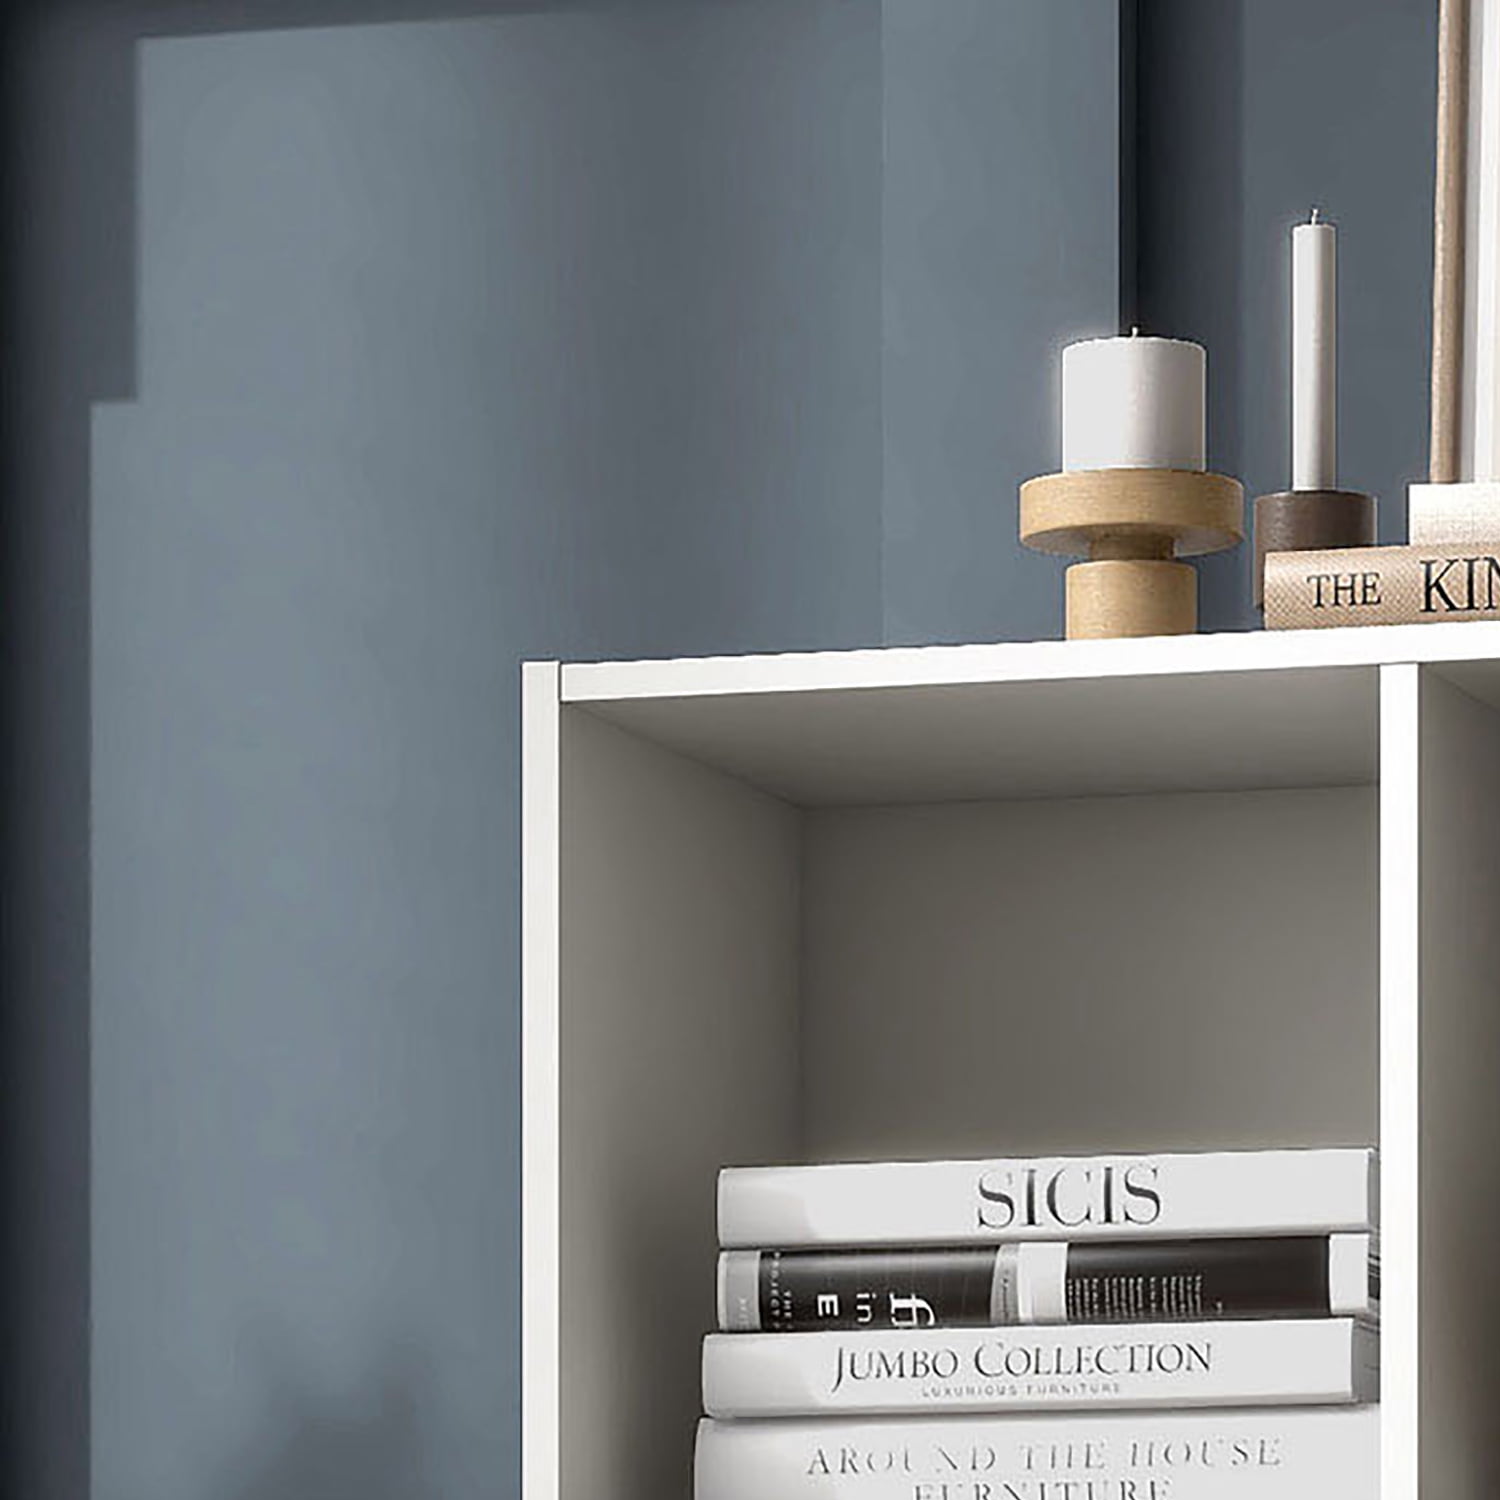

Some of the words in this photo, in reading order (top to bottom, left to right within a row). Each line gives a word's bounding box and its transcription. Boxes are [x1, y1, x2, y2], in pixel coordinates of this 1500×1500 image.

[1307, 571, 1382, 608] THE
[977, 1164, 1162, 1229] SICIS
[830, 1346, 959, 1393] JUMBO
[974, 1342, 1213, 1379] COLLECTION
[806, 1446, 997, 1475] AROUND
[1019, 1442, 1106, 1471] THE
[1130, 1438, 1282, 1468] HOUSE
